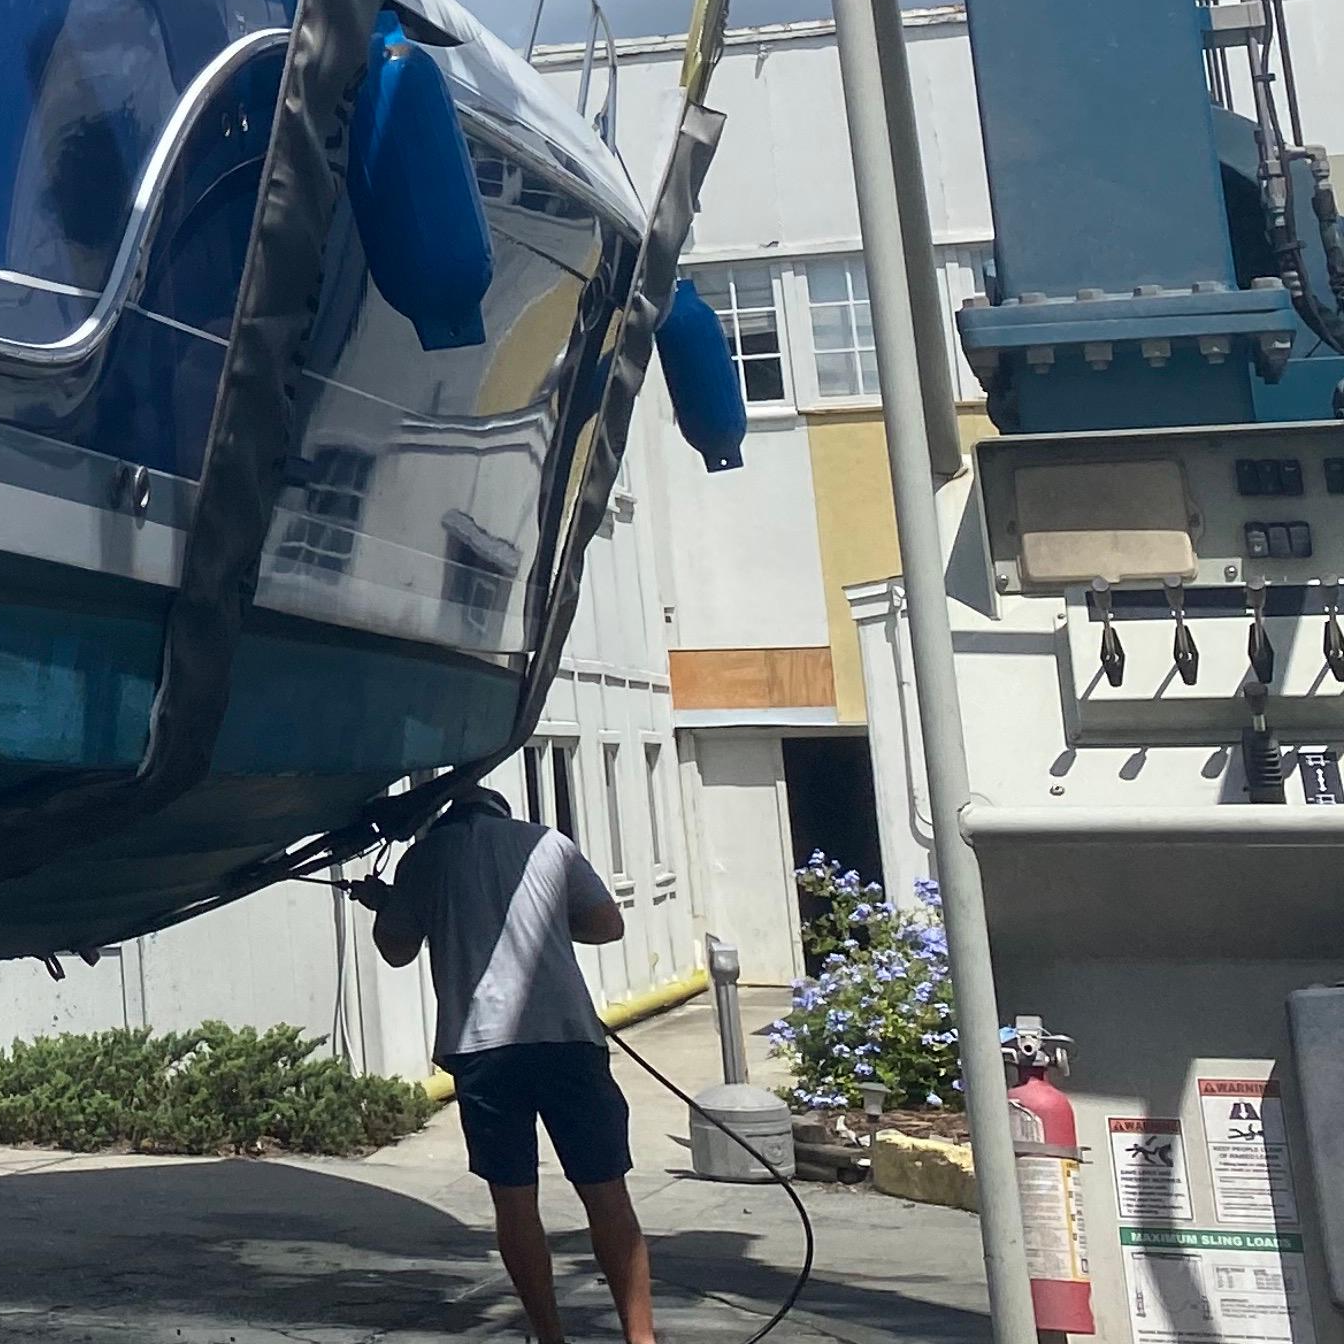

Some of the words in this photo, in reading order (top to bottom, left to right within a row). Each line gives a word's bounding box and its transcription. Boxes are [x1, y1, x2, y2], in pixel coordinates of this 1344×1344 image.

[1130, 1231, 1198, 1245] MAXIMUM
[1201, 1234, 1243, 1247] SLING
[1246, 1236, 1292, 1249] LOADS
